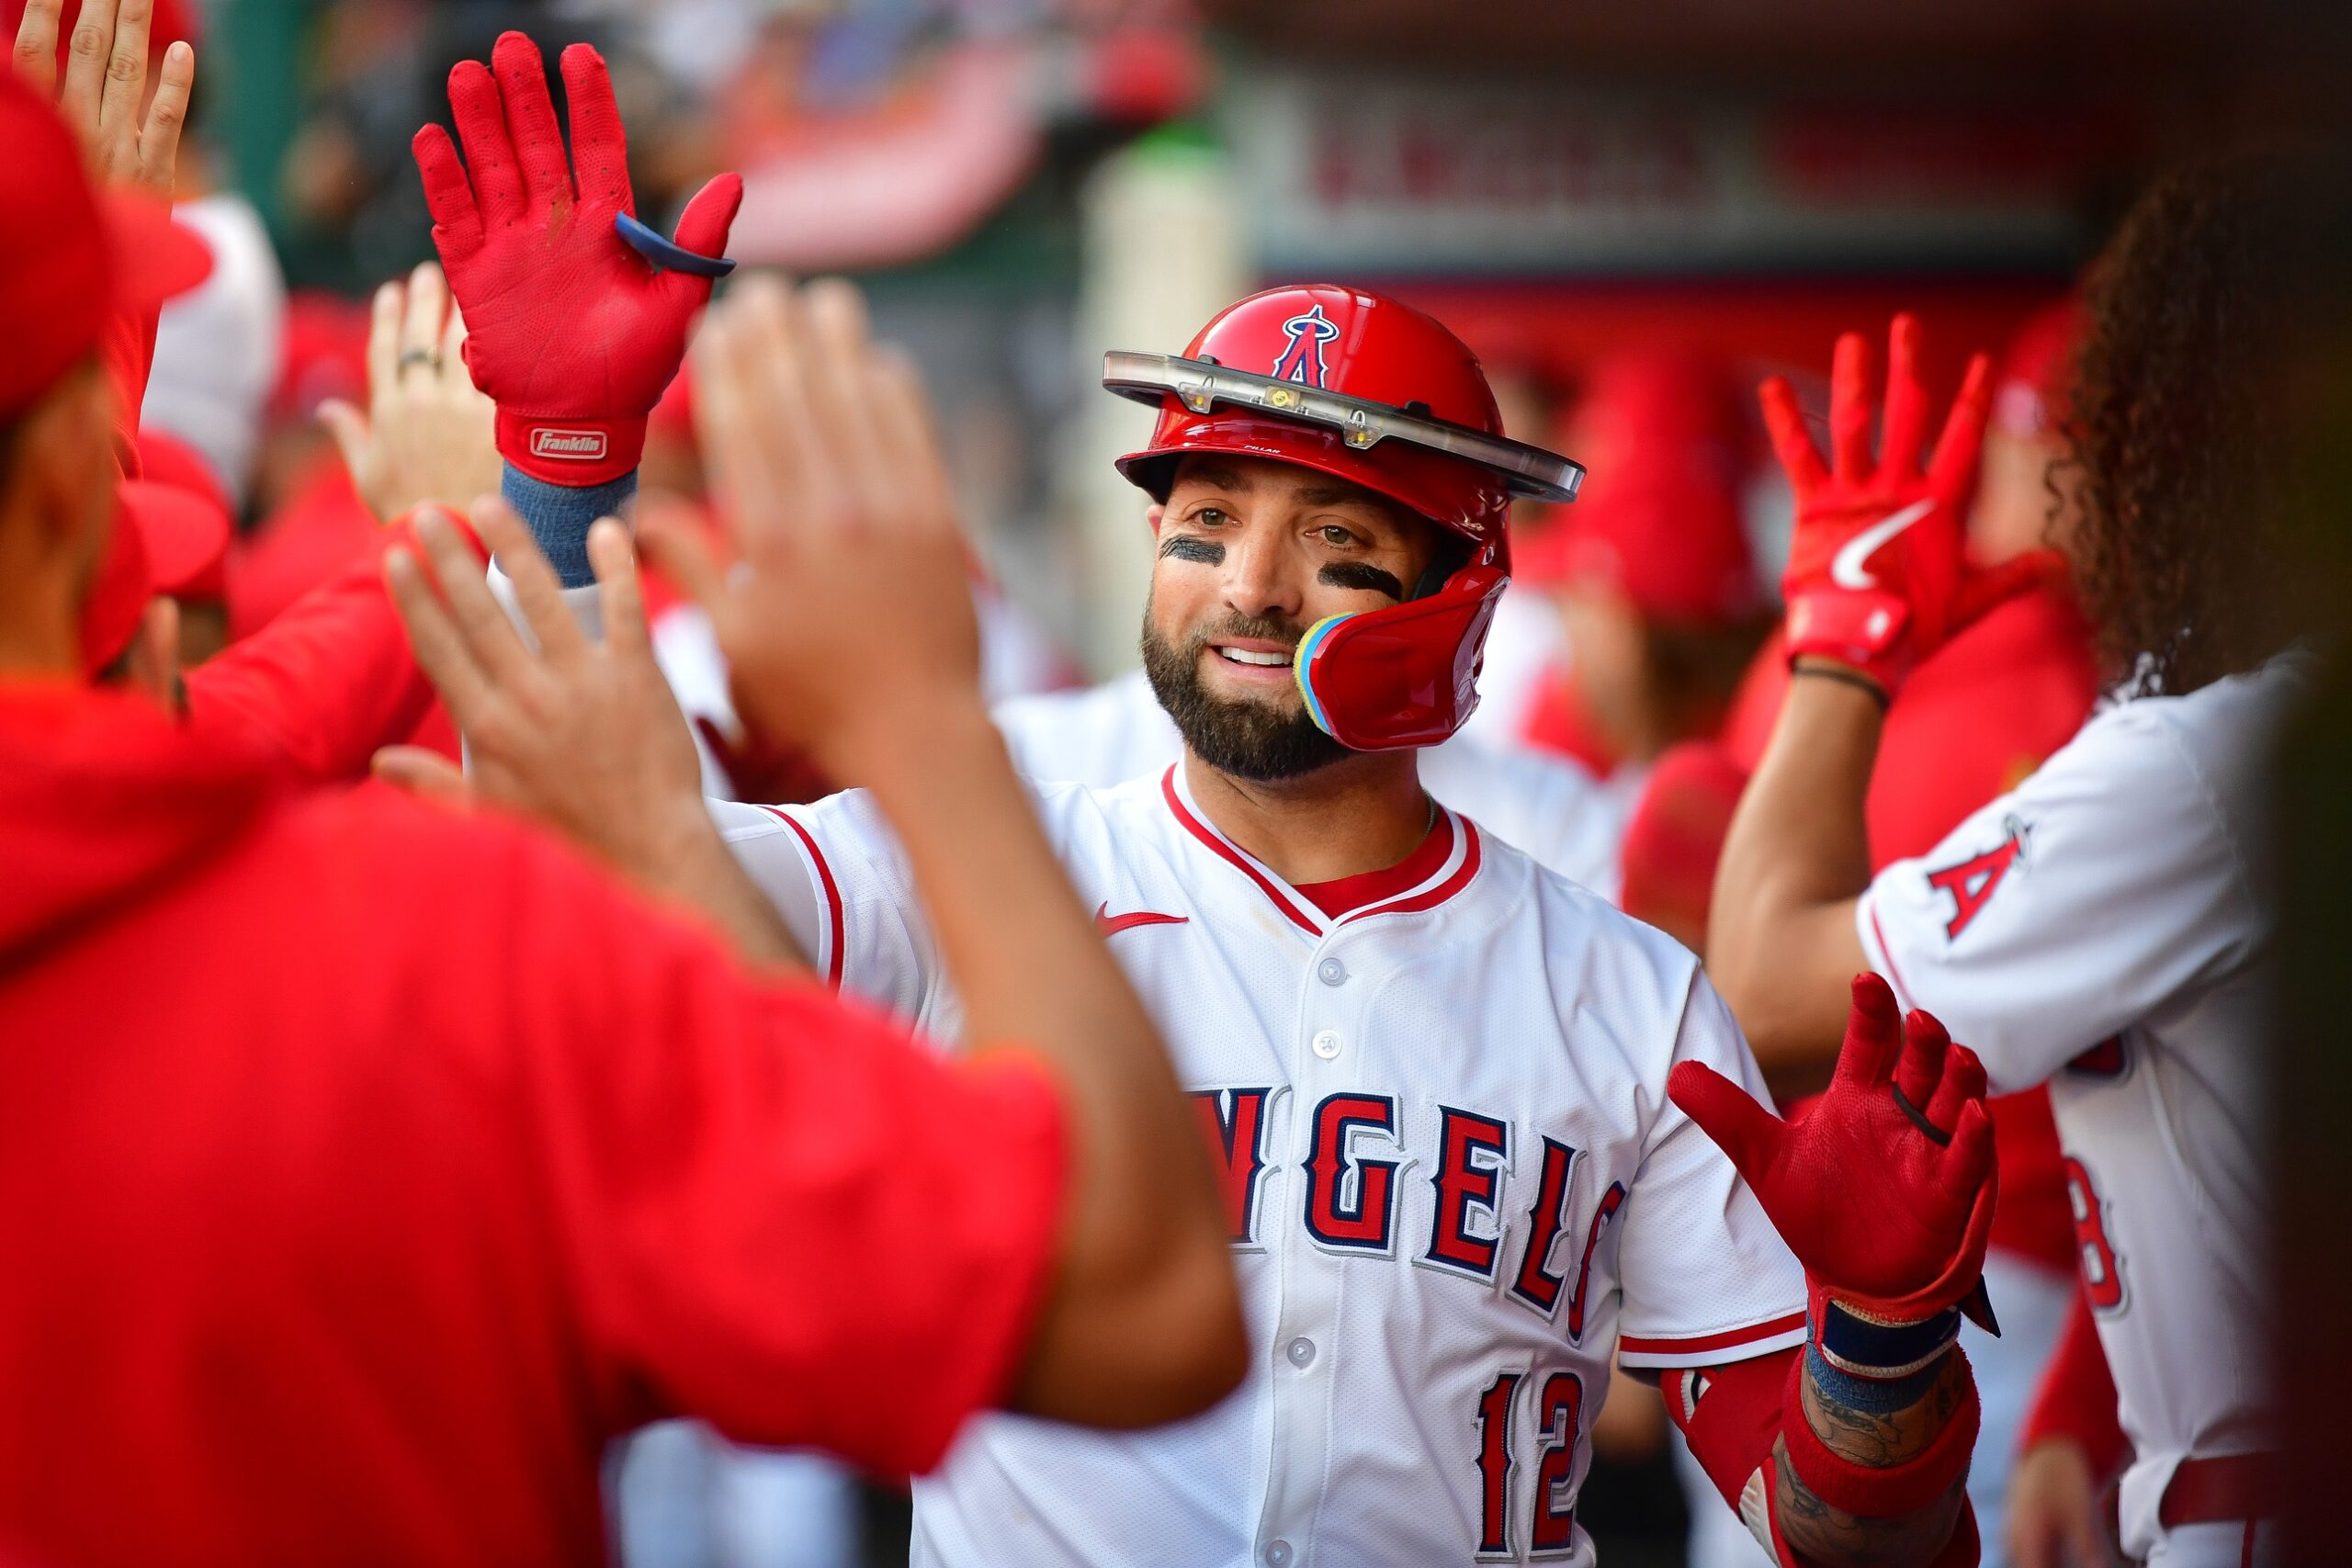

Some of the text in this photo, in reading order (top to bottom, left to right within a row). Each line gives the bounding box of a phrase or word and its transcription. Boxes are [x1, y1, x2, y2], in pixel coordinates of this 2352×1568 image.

[1243, 445, 1281, 454] PILLAR
[1182, 1084, 1627, 1347] NGELS
[1471, 1367, 1586, 1563] 12
